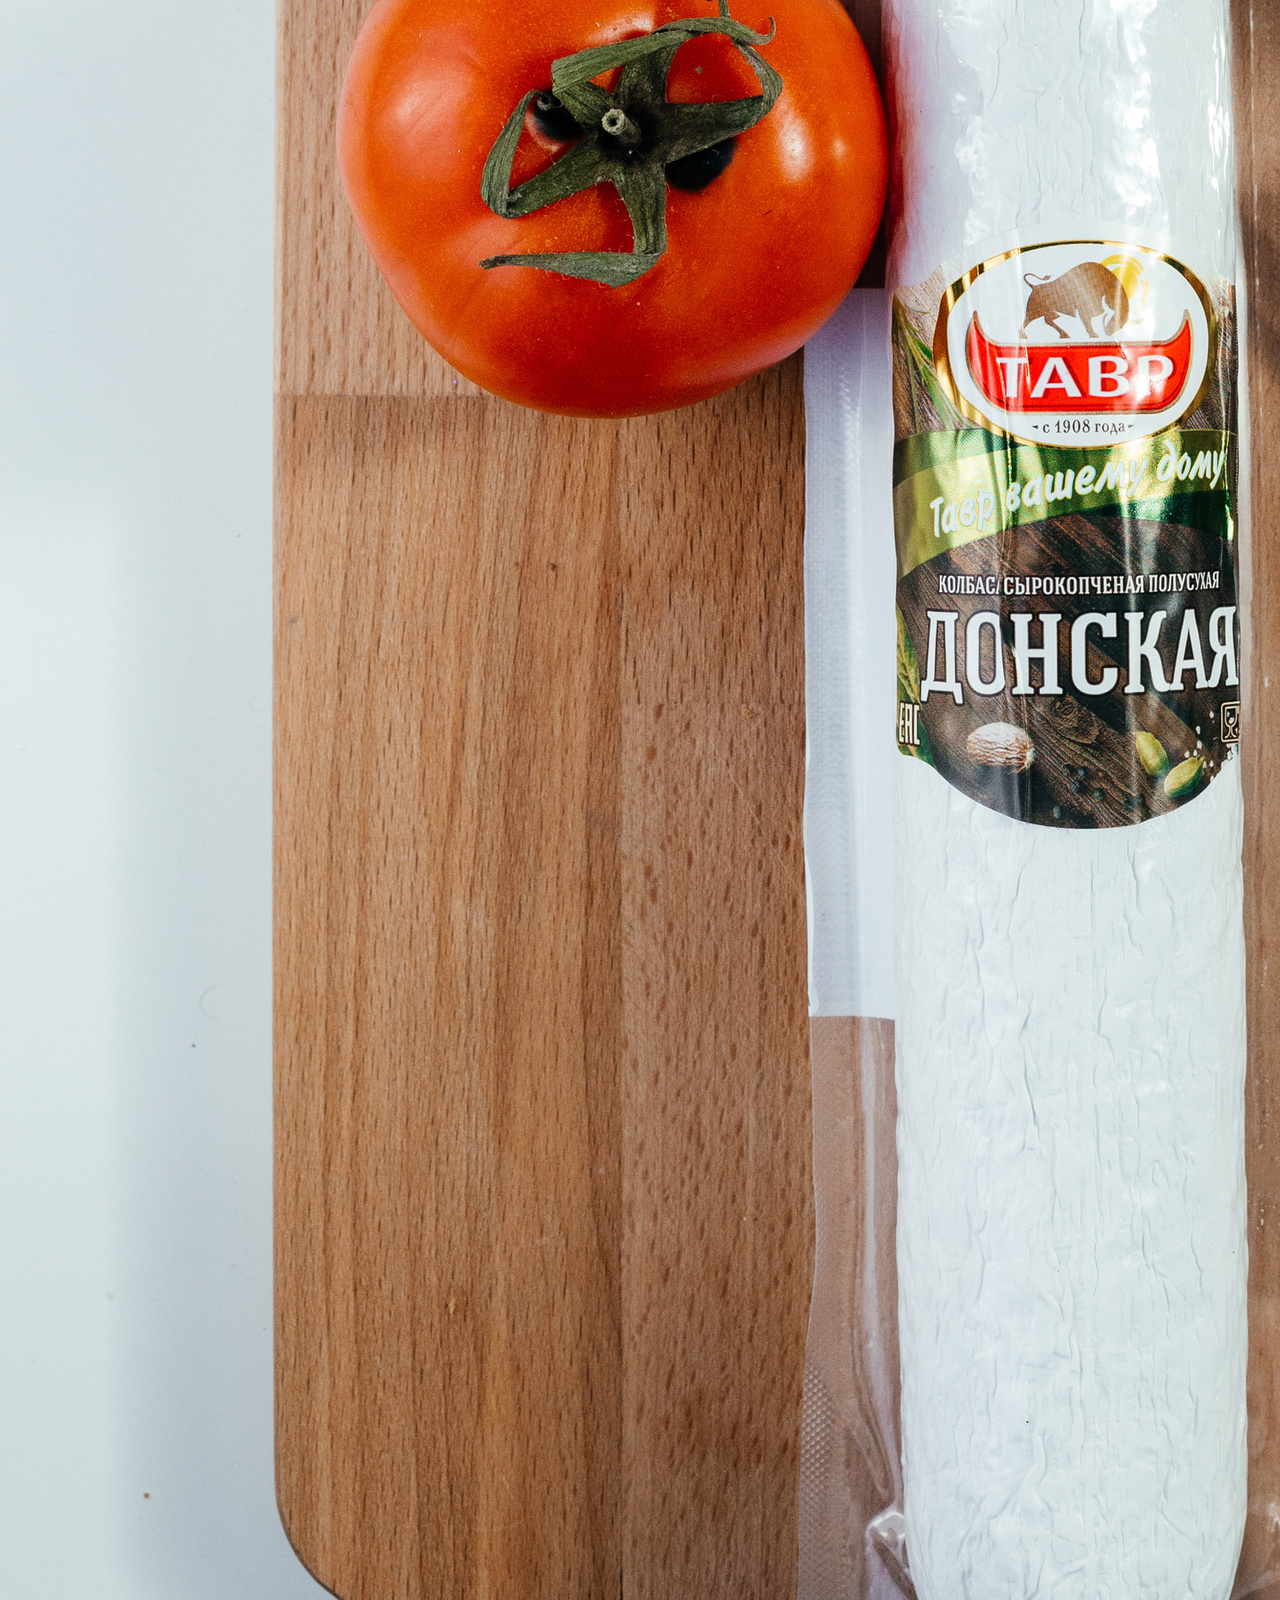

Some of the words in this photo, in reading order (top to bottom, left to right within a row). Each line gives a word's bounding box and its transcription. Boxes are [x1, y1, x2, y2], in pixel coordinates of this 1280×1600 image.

[995, 354, 1174, 399] ТАВР
[1042, 423, 1051, 434] с
[1054, 419, 1091, 434] 1908
[1094, 422, 1125, 436] года
[929, 489, 996, 538] Тавр
[1005, 456, 1149, 512] вашему
[1156, 438, 1226, 490] дому
[1003, 574, 1145, 596] СЫРОКОПЧЕНАЯ
[1148, 570, 1220, 593] ПОЛУСУХАЯ
[920, 605, 1239, 705] ДОНСКАЯ
